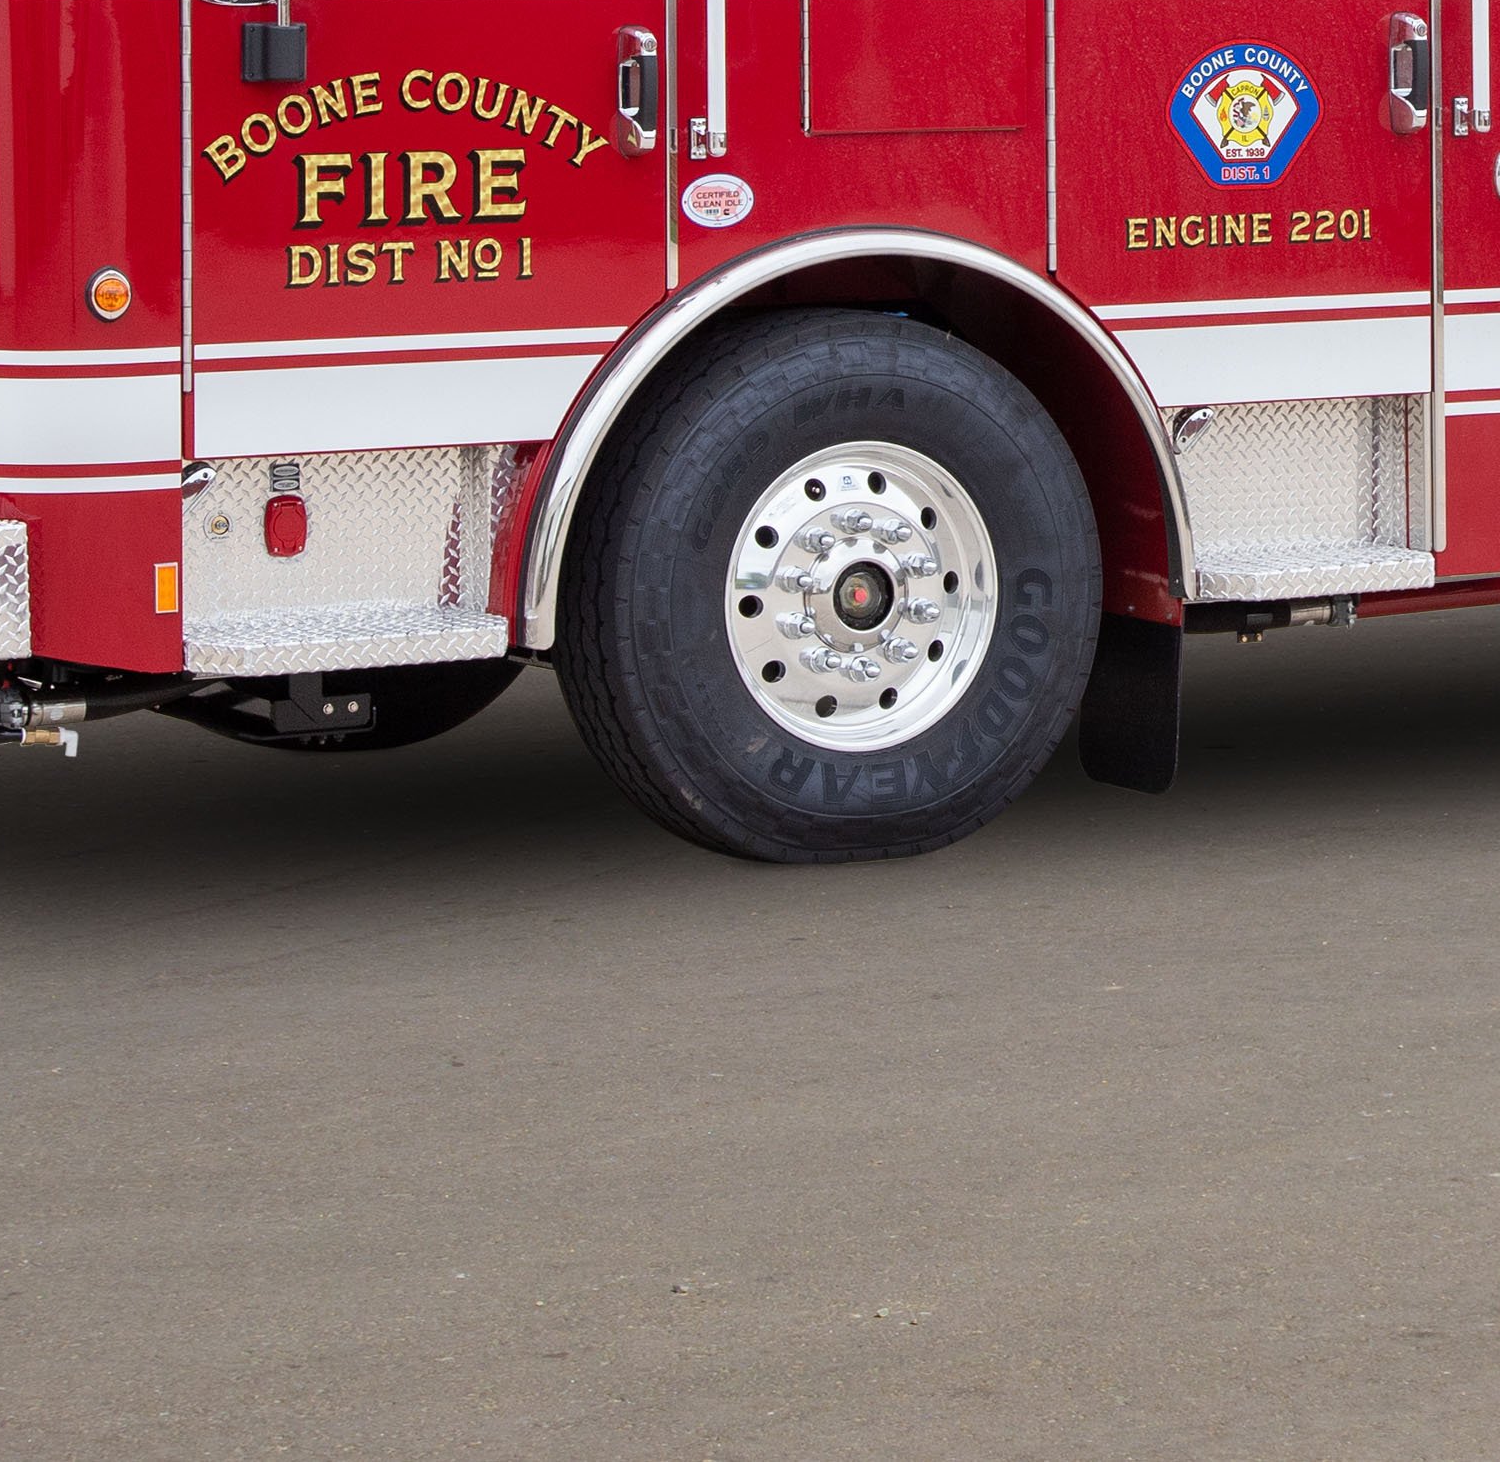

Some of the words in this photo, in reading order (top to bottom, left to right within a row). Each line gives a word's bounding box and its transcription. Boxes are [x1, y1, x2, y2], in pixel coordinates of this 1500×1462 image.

[1181, 49, 1236, 99] BOONE
[1244, 47, 1309, 94] COUNTY
[1231, 85, 1260, 97] CAPRON
[202, 71, 384, 185] BOONE
[400, 68, 610, 168] COUNTY
[1221, 166, 1260, 181] DIST.
[1263, 165, 1270, 180] 1
[1225, 148, 1244, 158] EST.
[1246, 147, 1266, 157] 1939
[293, 147, 528, 229] FIRE
[692, 201, 722, 209] CLEAN
[724, 198, 744, 207] IDLE
[696, 190, 740, 200] CERTIFIED
[1126, 213, 1273, 251] ENGINE
[1287, 208, 1372, 245] 2201
[285, 241, 415, 289] DIST
[518, 236, 535, 281] 1
[768, 567, 1053, 804] GOODYEAR
